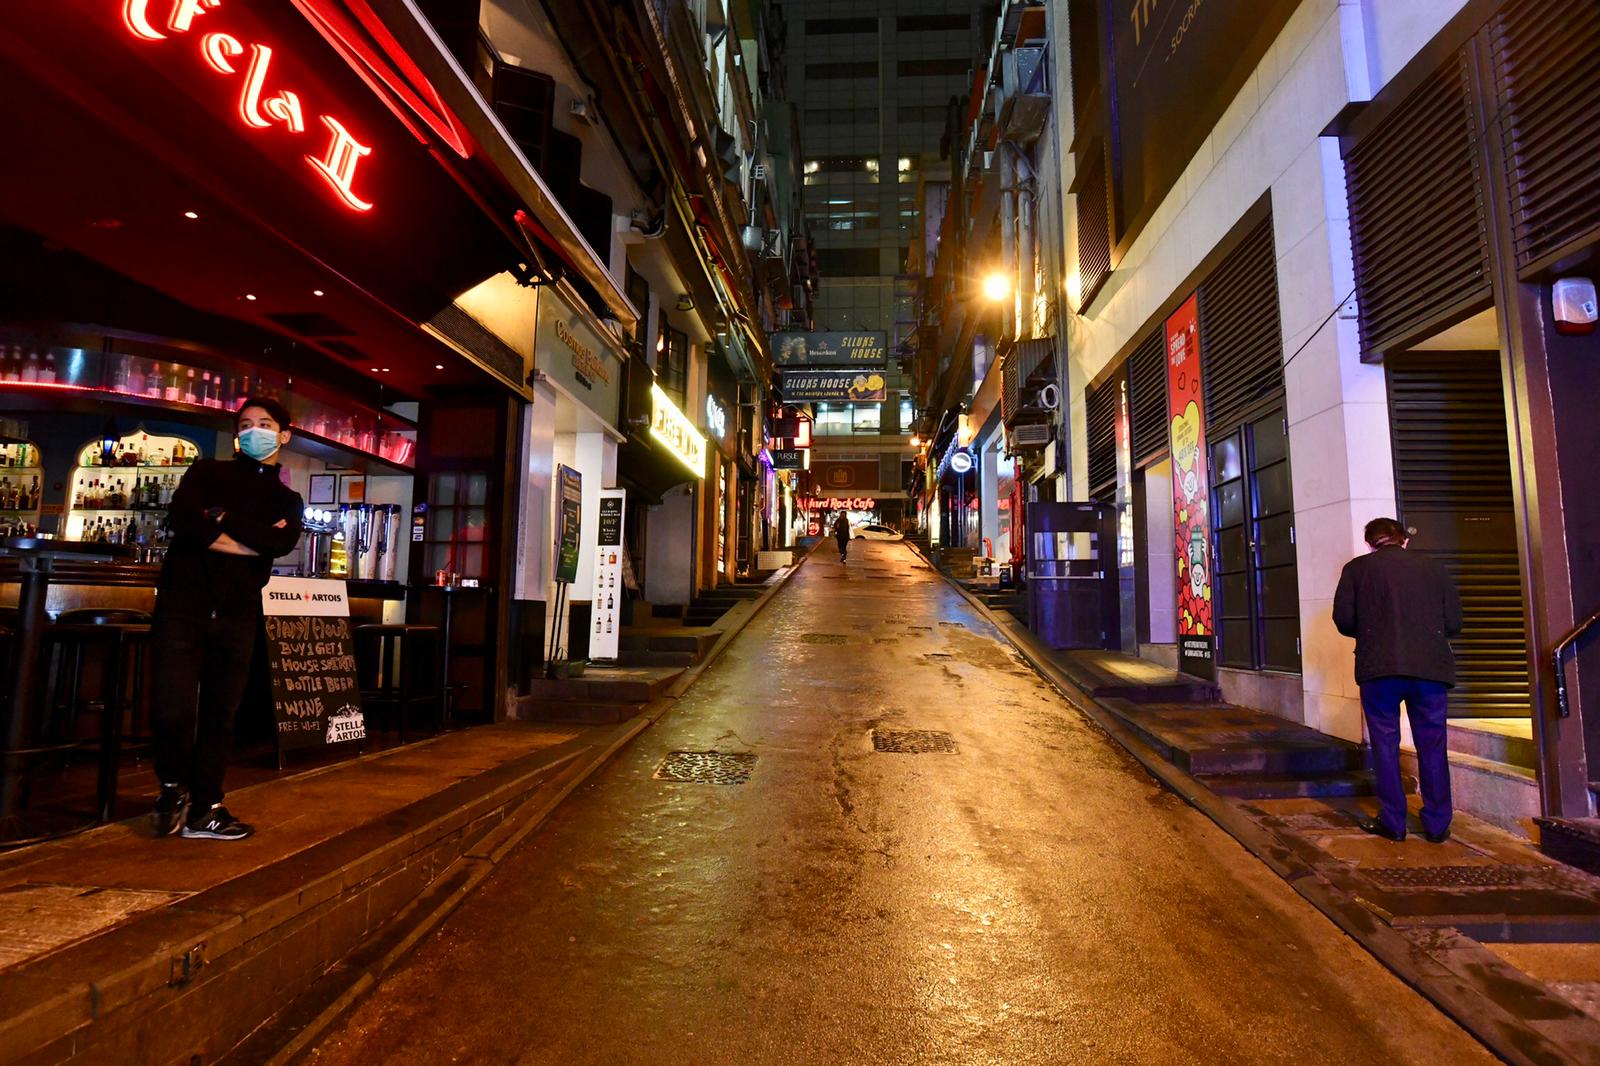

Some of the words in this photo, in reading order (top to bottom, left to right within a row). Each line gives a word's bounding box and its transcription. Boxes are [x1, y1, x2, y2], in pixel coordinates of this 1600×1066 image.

[850, 348, 884, 359] HOUSE
[819, 378, 851, 389] HOUSE
[777, 452, 799, 460] PURSUE
[830, 497, 853, 510] Rock
[853, 497, 875, 510] Cafe
[269, 591, 302, 601] STELLA
[311, 593, 342, 602] ARTOIS
[278, 641, 305, 656] BUY
[315, 641, 336, 655] GET
[284, 696, 325, 718] WINE
[278, 720, 298, 732] FREE
